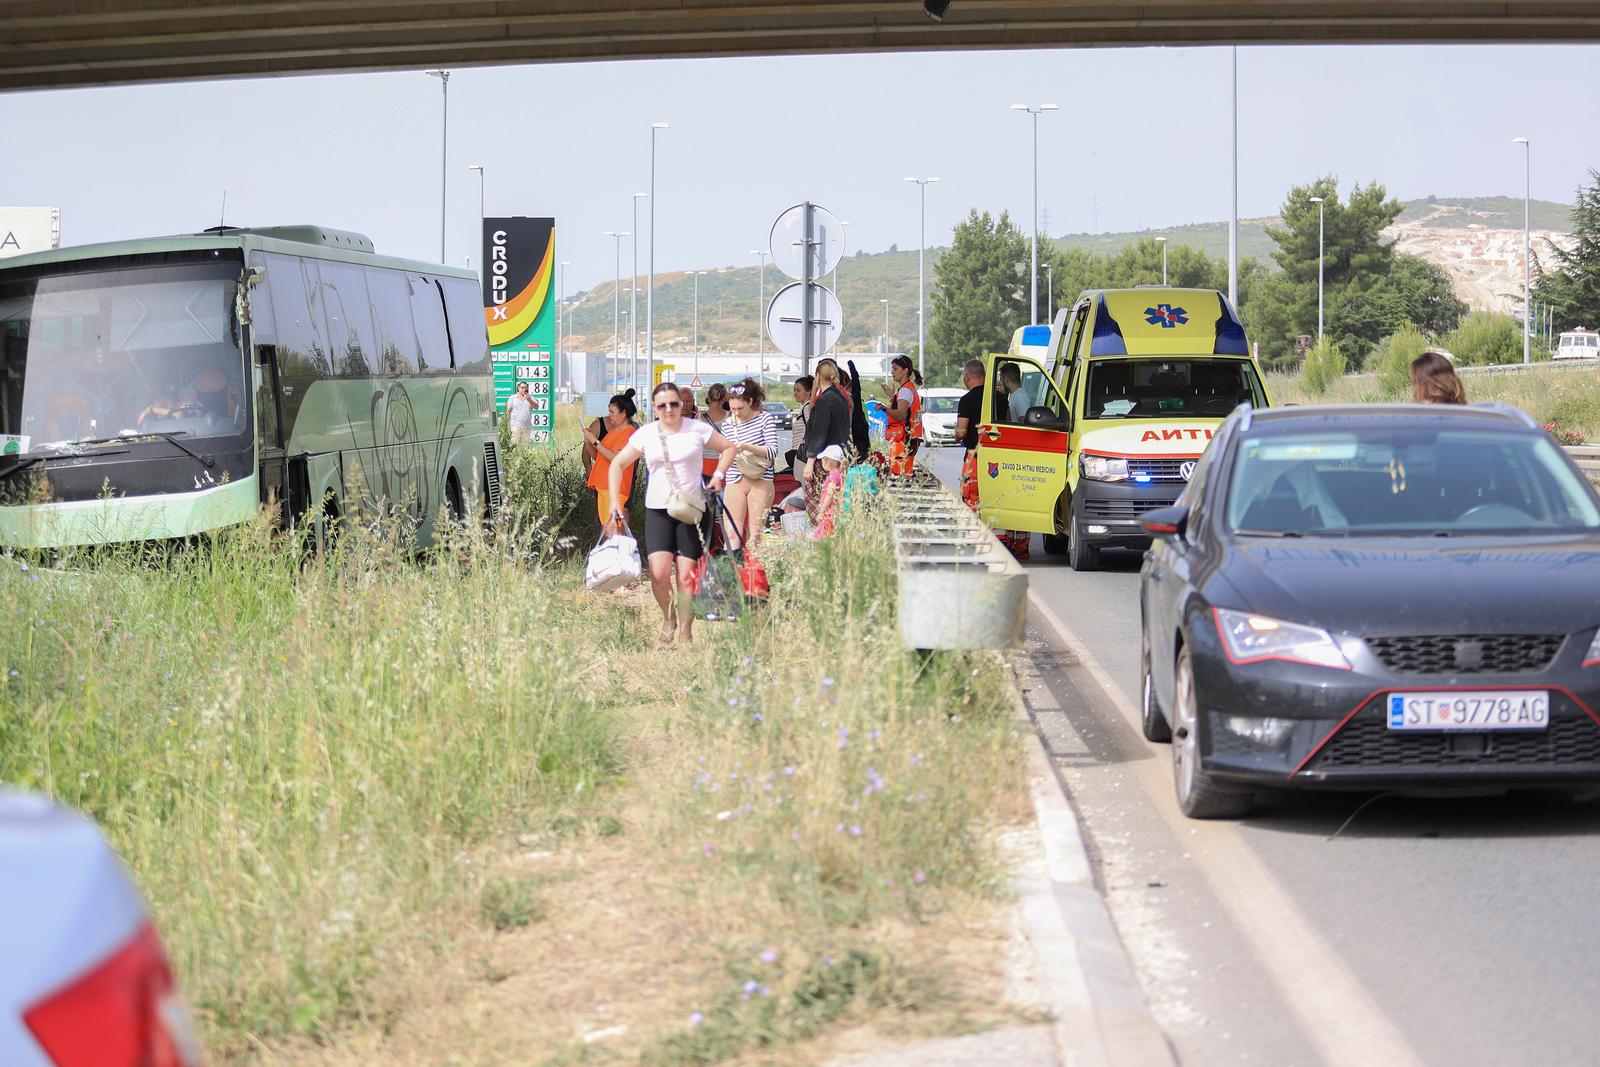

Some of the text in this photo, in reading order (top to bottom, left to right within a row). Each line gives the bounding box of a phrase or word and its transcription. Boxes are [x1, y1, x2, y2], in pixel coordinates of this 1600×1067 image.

[492, 230, 508, 320] CRODUX
[516, 366, 548, 378] 01.43
[1408, 700, 1434, 724] ST
